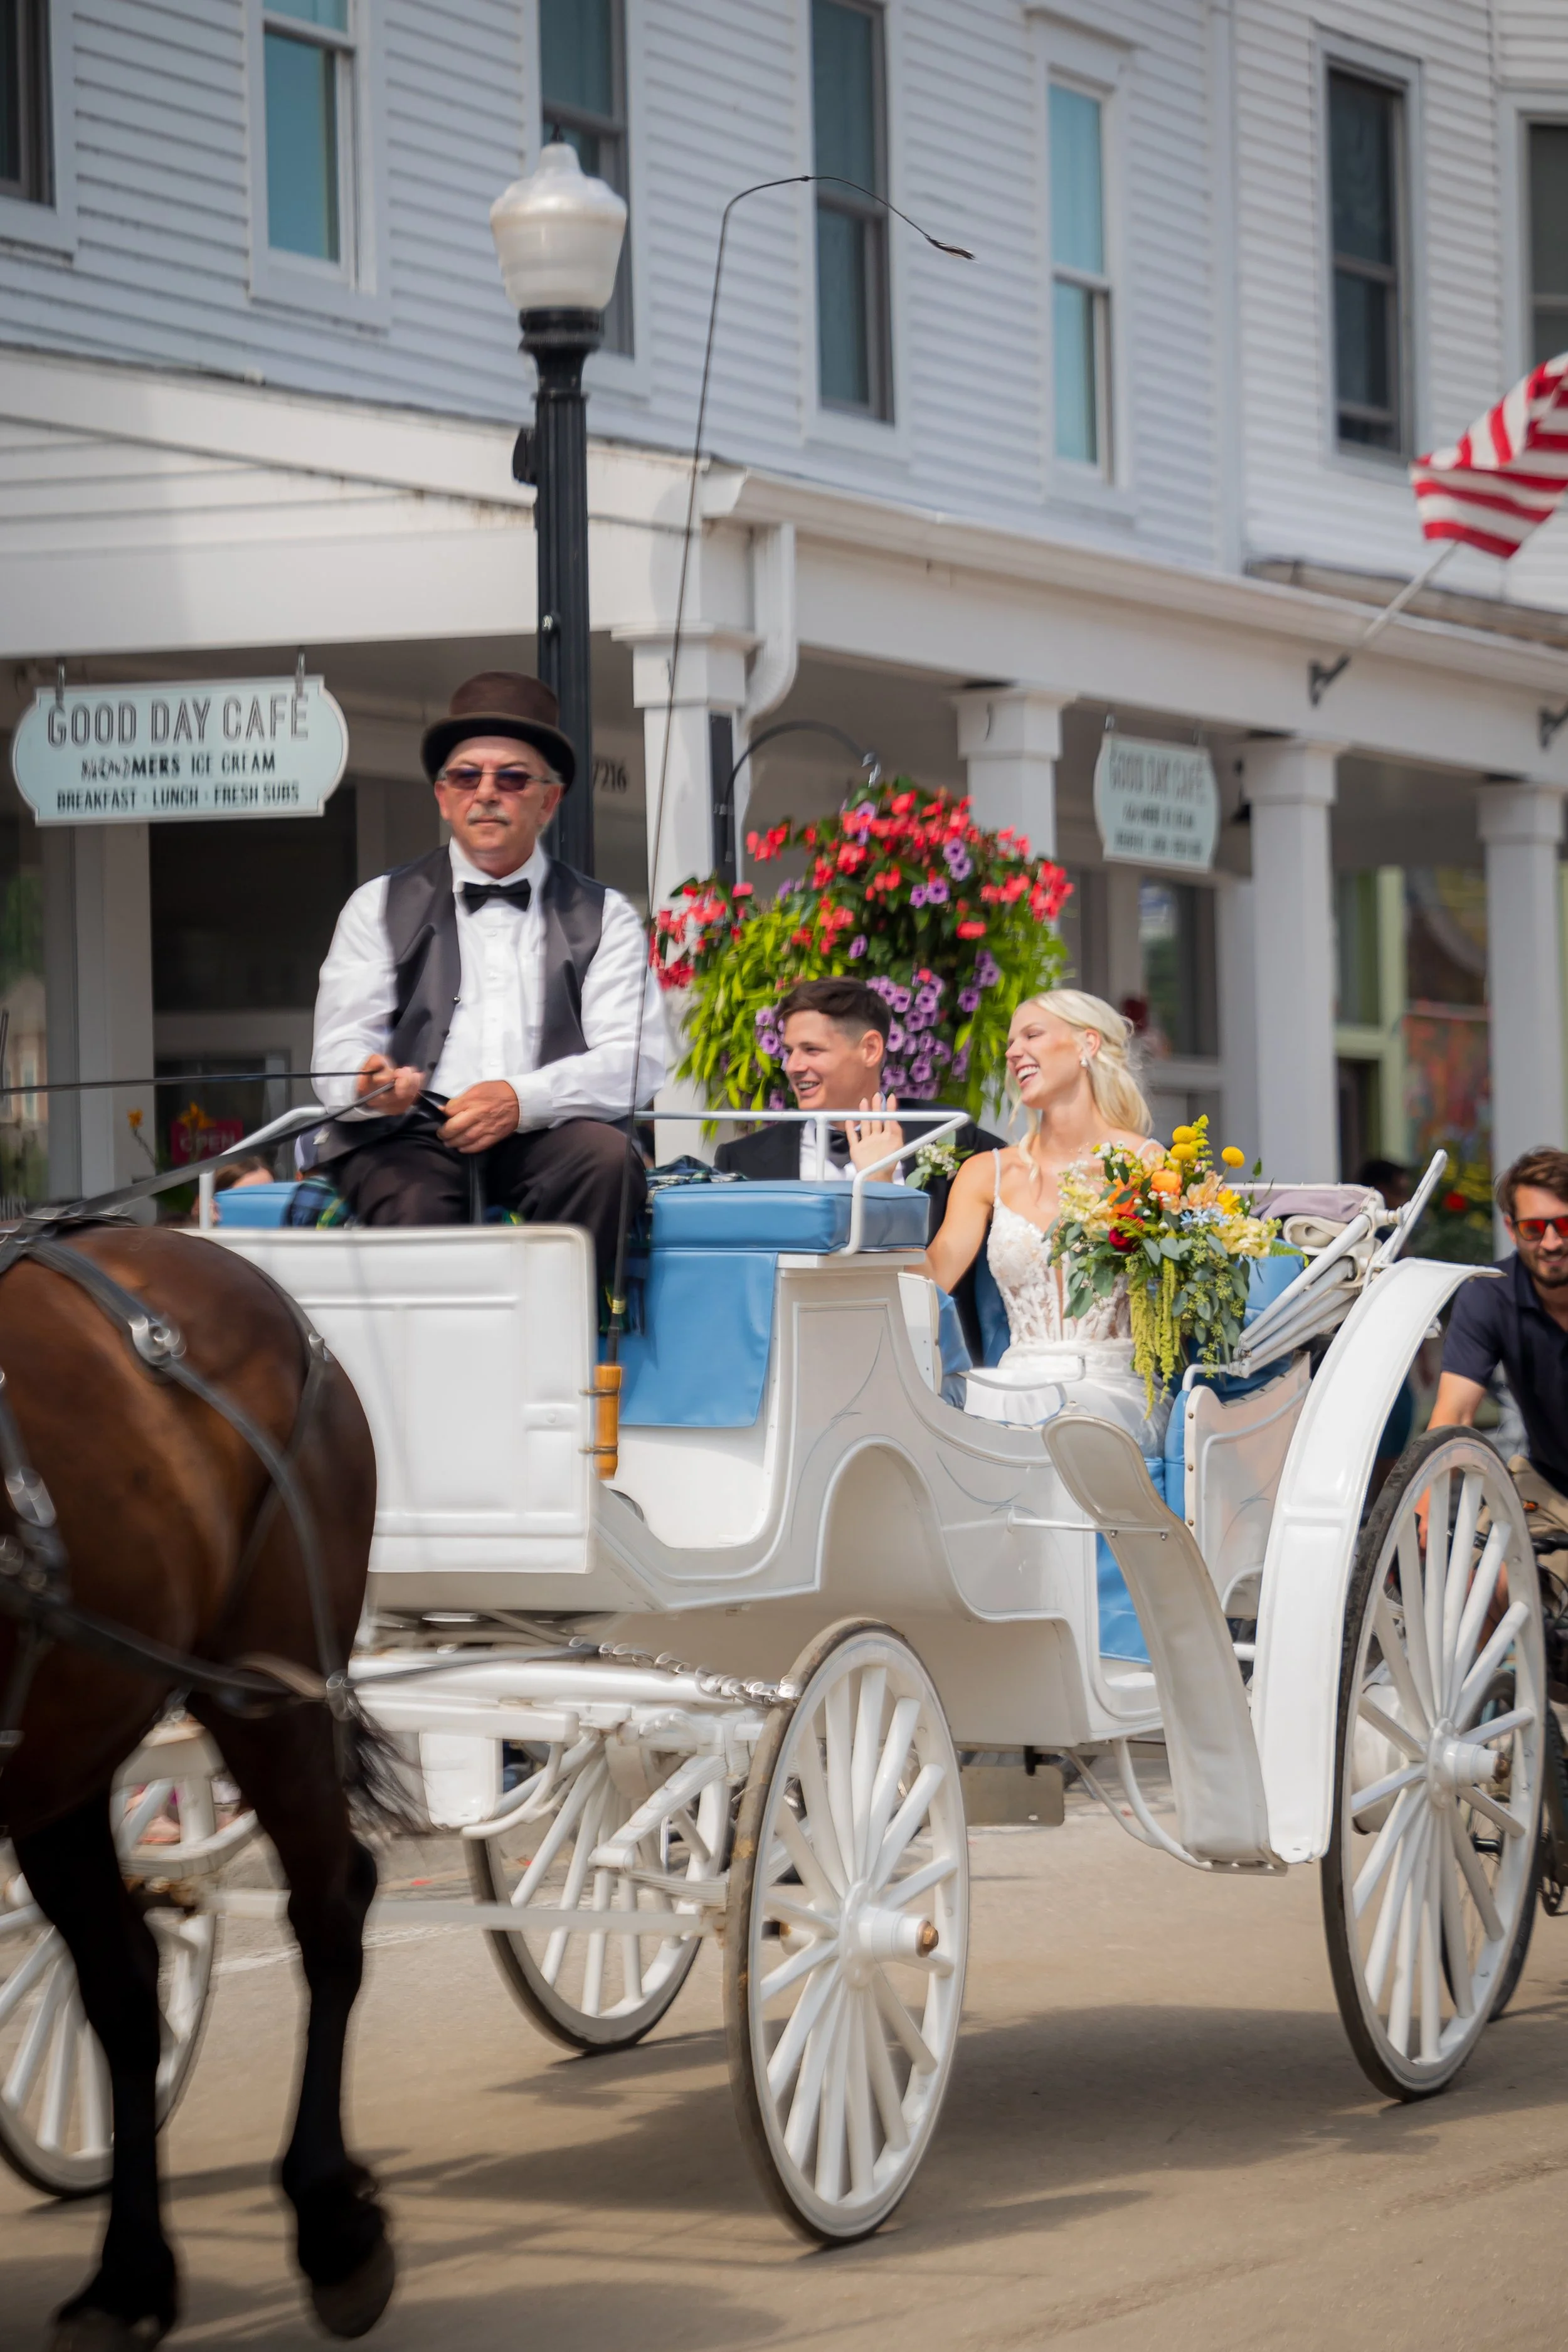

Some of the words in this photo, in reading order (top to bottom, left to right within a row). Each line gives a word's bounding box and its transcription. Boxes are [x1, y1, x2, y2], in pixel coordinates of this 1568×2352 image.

[48, 699, 137, 749] GOOD
[151, 697, 211, 746] DAY
[191, 751, 211, 778] ICE
[221, 749, 276, 777] CREAM
[57, 786, 136, 814] BREAKFAST
[153, 784, 198, 810] LUNCH
[214, 781, 258, 808] FRESH
[263, 780, 299, 807] SUBS
[179, 1130, 236, 1153] OPEN
